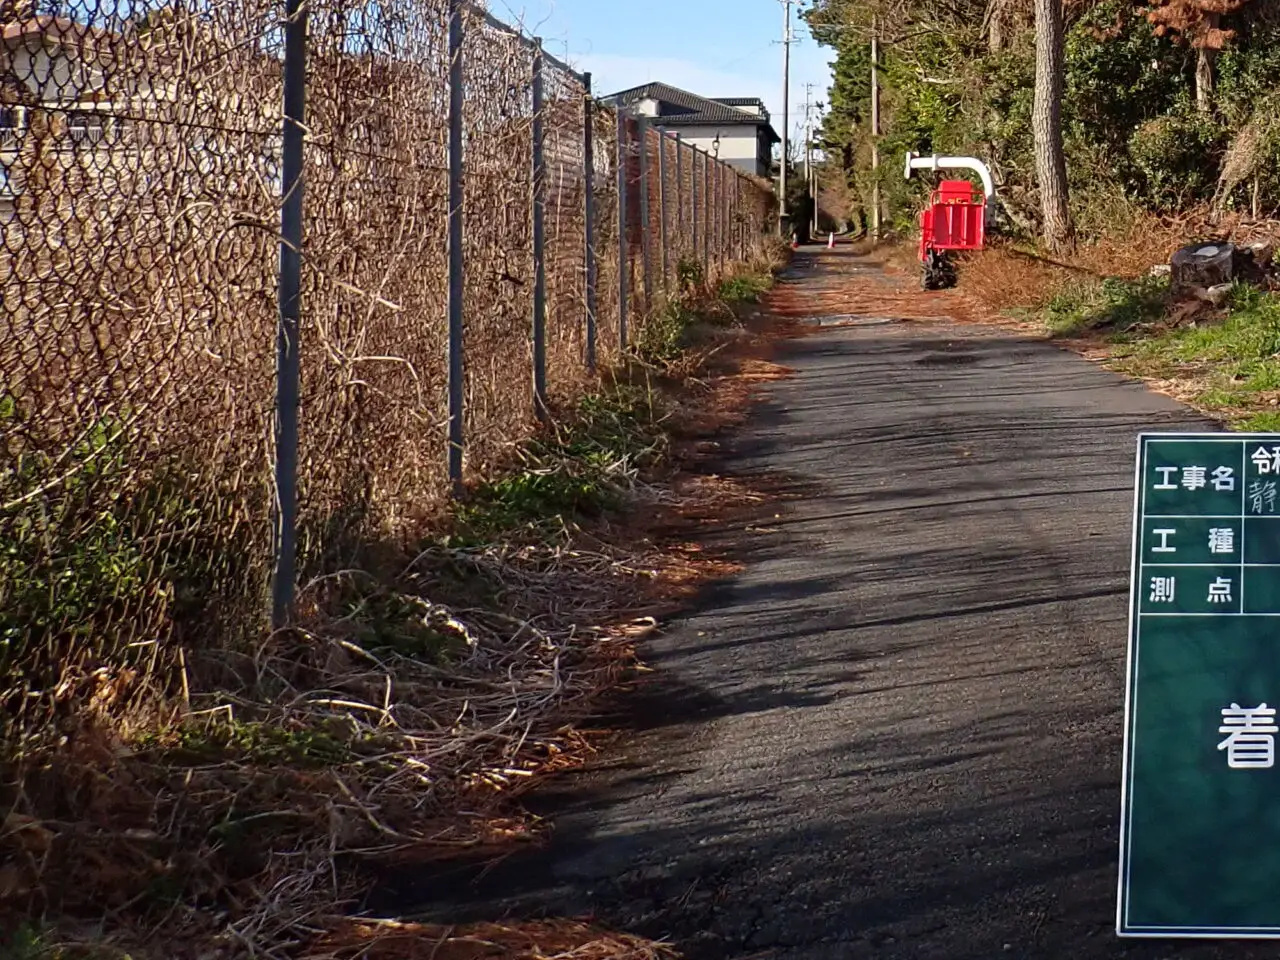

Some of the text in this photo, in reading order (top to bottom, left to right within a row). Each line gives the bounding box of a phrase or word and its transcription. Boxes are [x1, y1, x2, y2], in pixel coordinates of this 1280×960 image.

[1153, 466, 1235, 491] 工事名
[1151, 528, 1235, 554] 工種
[1149, 577, 1233, 603] 測点
